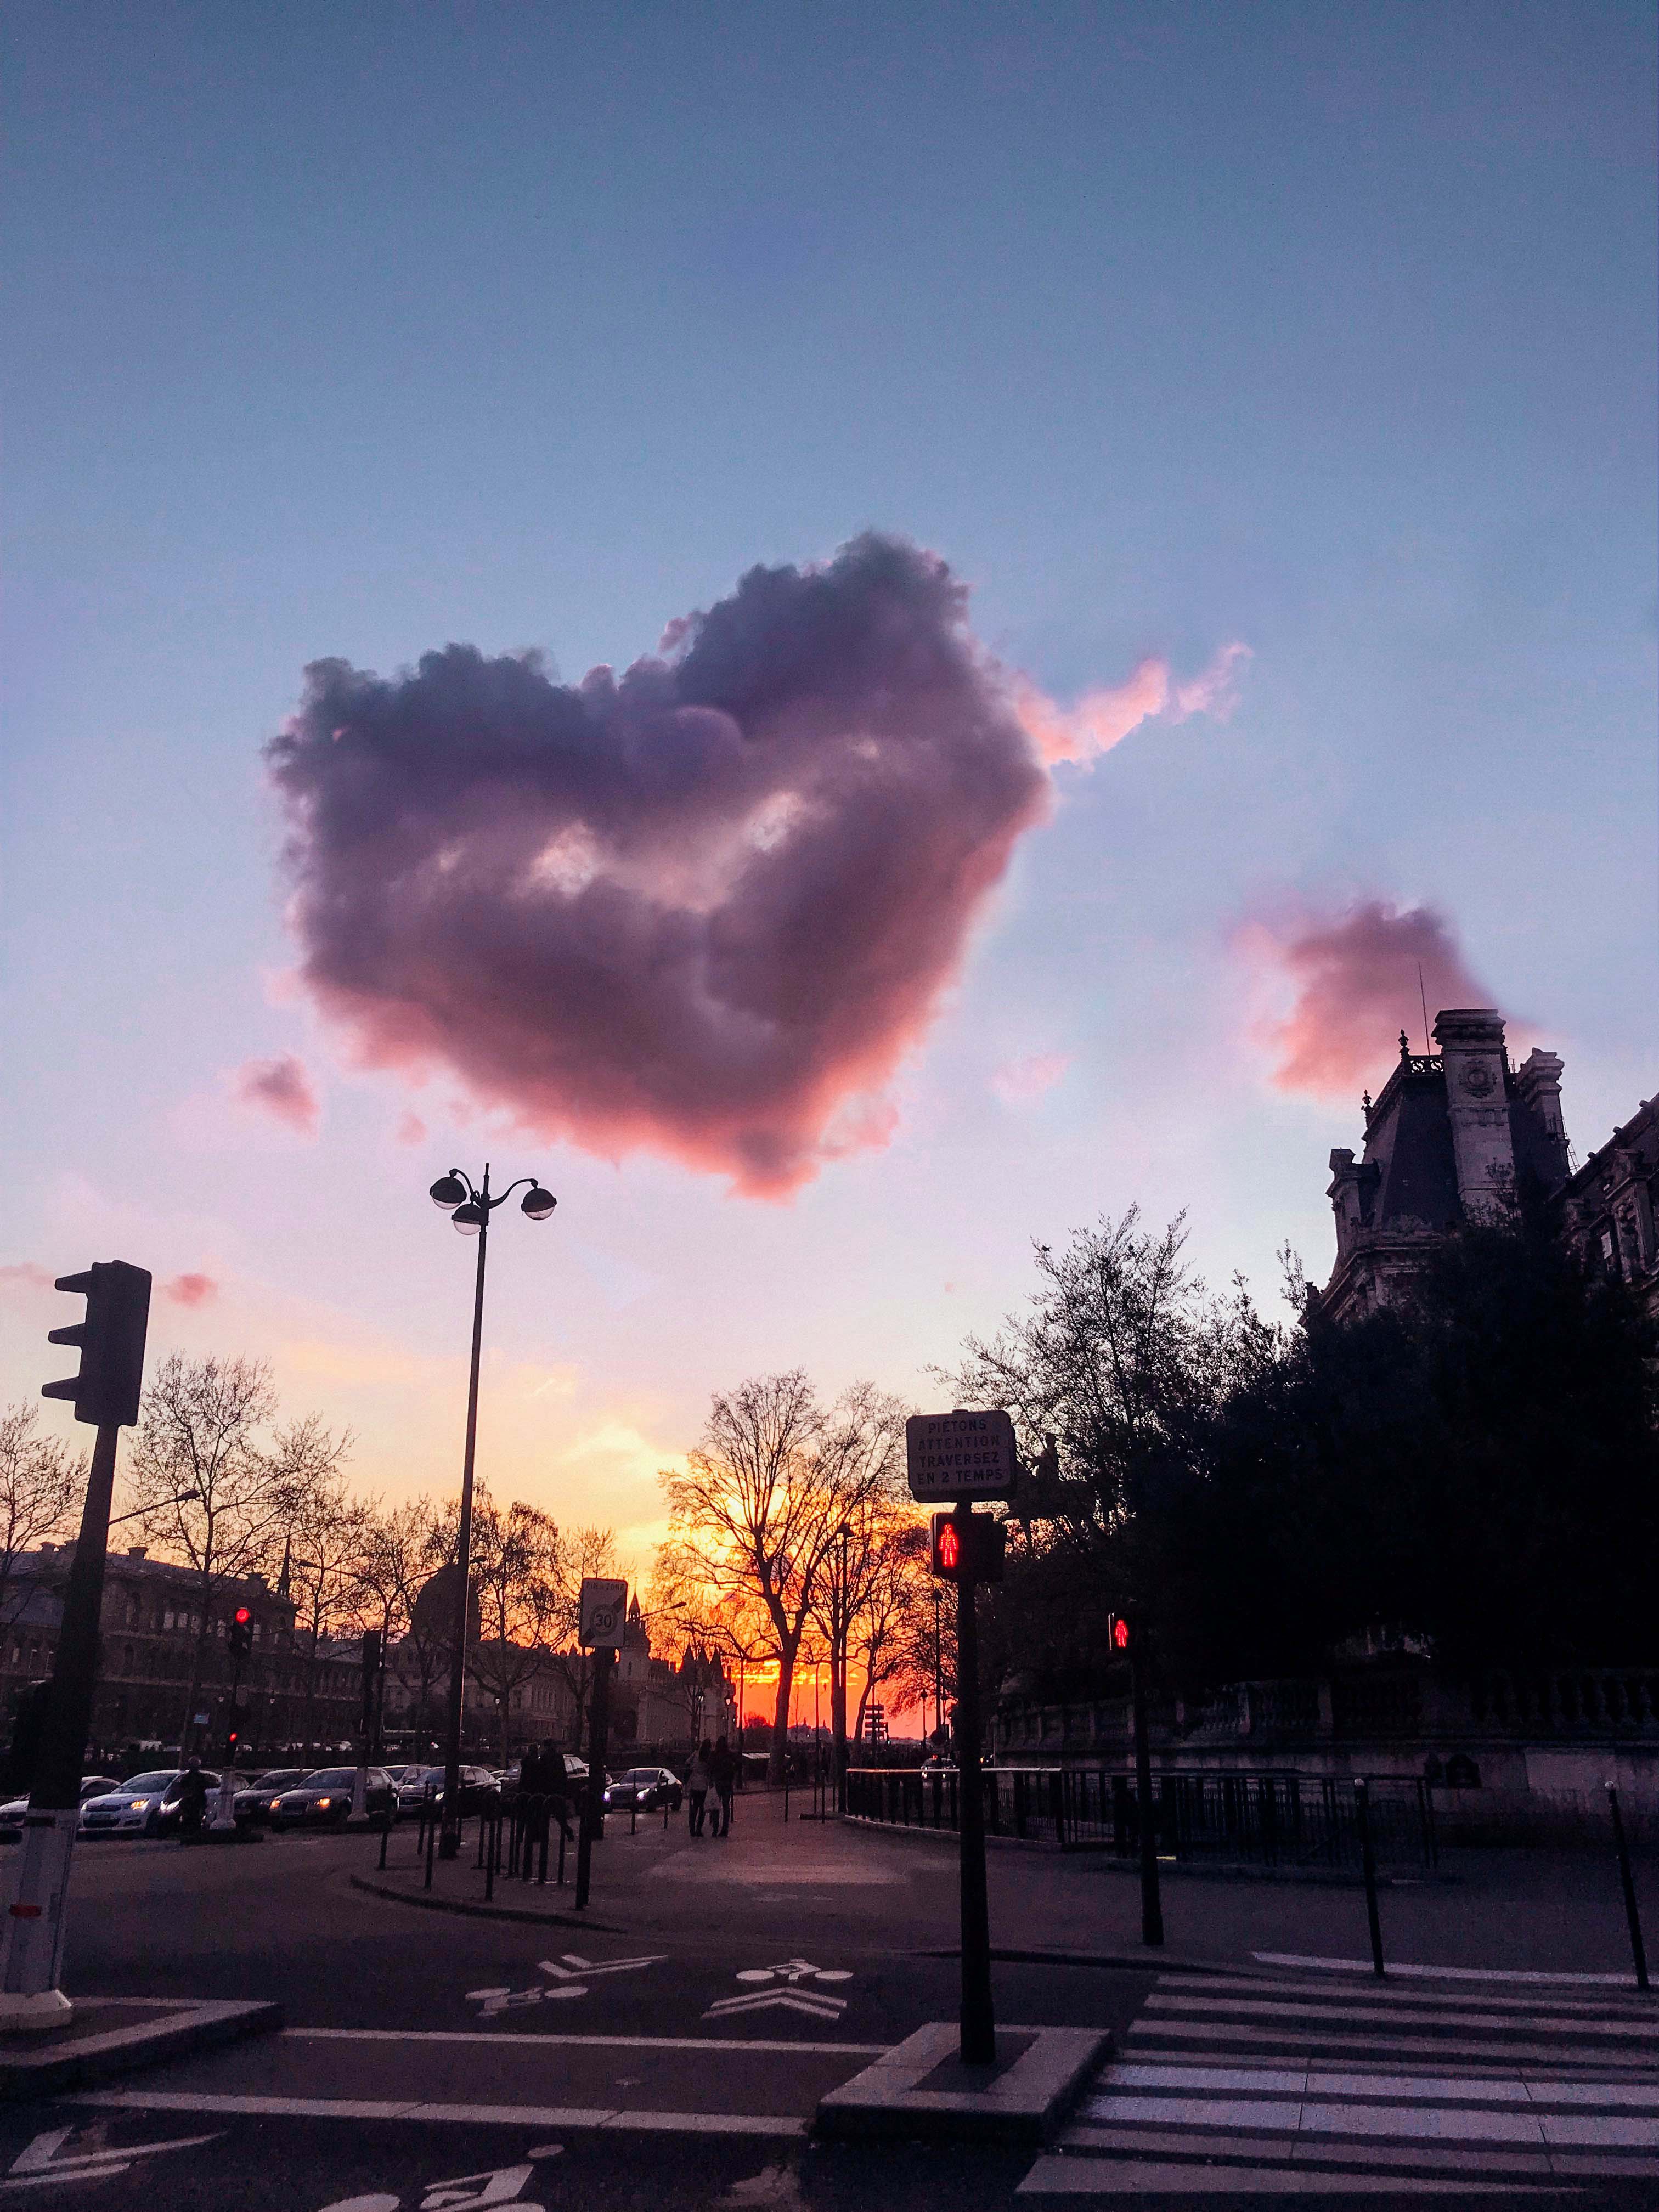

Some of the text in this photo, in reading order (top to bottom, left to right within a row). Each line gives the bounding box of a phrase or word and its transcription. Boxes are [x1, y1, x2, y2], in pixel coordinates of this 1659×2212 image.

[918, 1435, 1000, 1451] ATTENTION
[919, 1452, 1000, 1468] TRAVERSEZ
[917, 1468, 1003, 1485] EN 2 TEMPS
[595, 1614, 612, 1628] 30
